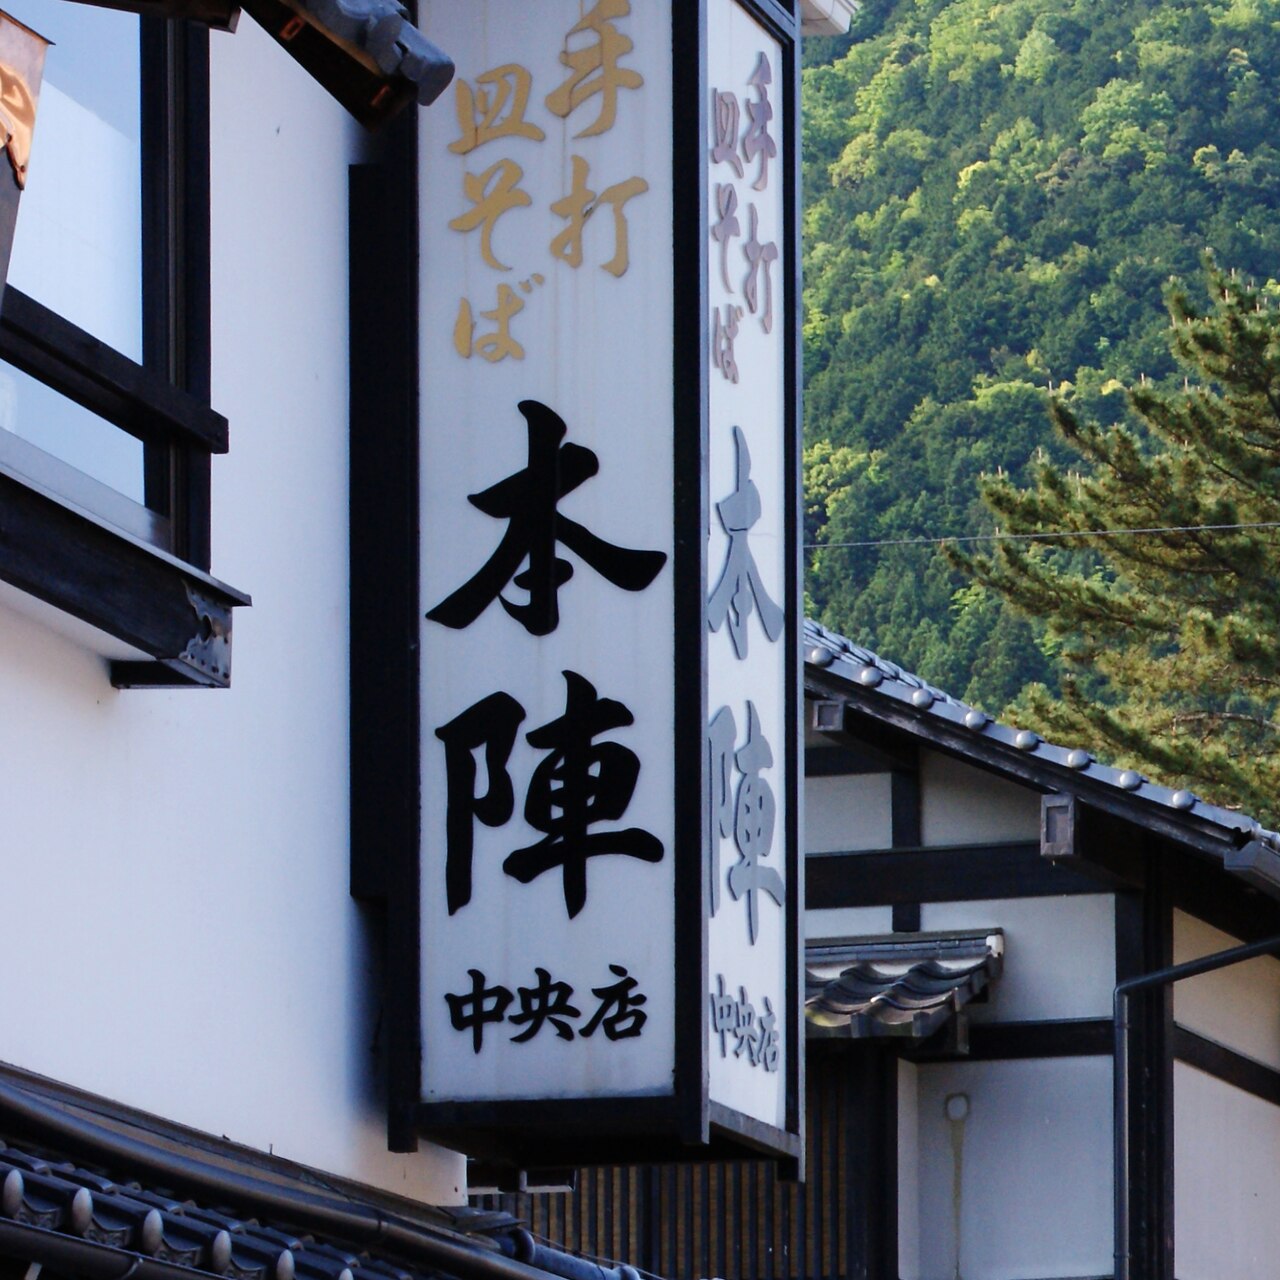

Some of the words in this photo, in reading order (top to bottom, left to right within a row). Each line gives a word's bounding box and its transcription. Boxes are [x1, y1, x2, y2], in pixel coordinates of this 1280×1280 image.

[447, 63, 545, 363] 皿そば
[544, 0, 649, 278] 手打
[425, 399, 668, 920] 本陣
[708, 425, 784, 945] 本陣
[444, 964, 648, 1054] 中央店
[711, 974, 780, 1073] 中央店
